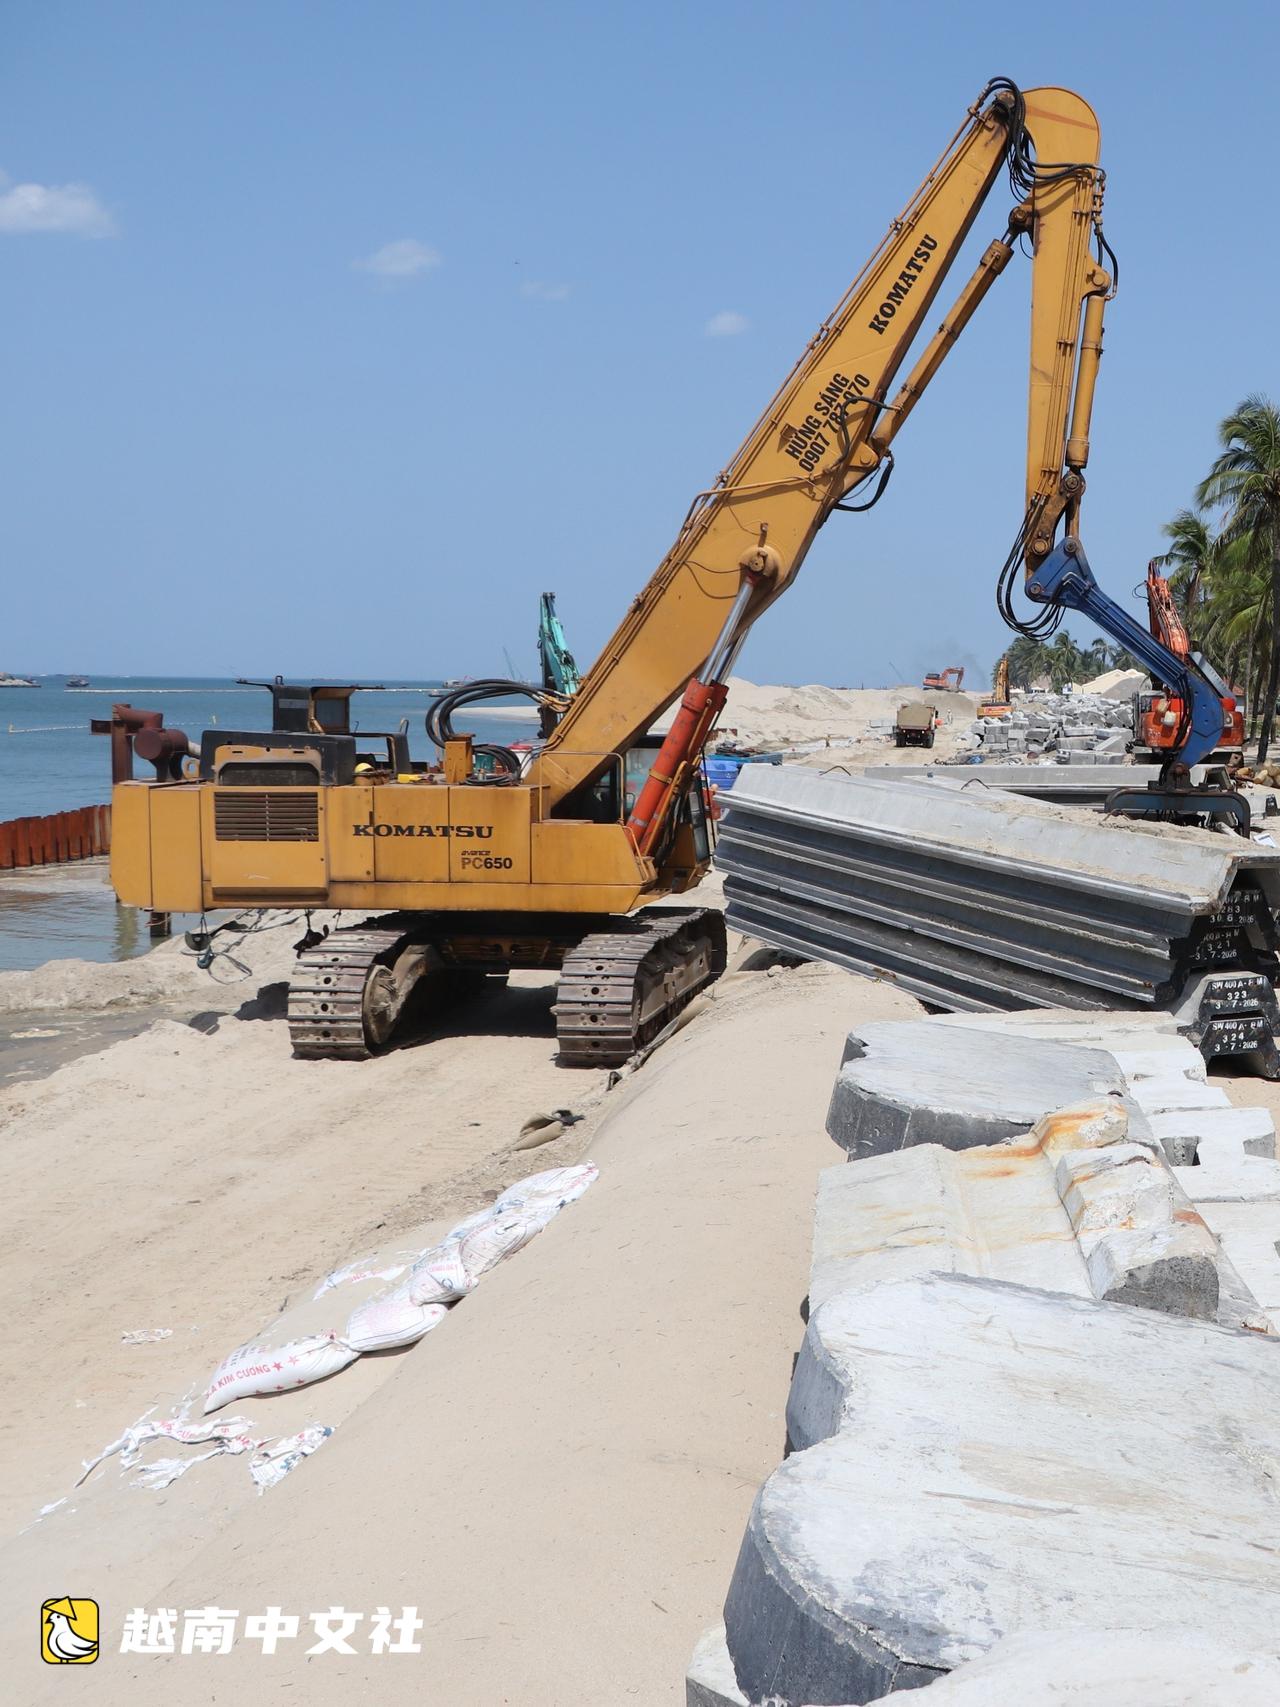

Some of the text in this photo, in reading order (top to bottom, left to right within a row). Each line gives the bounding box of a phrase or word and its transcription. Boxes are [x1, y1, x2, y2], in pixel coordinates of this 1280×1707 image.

[868, 234, 938, 335] KOMATSU
[814, 373, 850, 416] SÁNG
[798, 432, 830, 472] 0907
[352, 824, 494, 839] KOMATSU
[461, 857, 513, 869] PC650
[1226, 991, 1247, 1000] 323
[1222, 1032, 1245, 1043] 324
[217, 1374, 236, 1388] KIM
